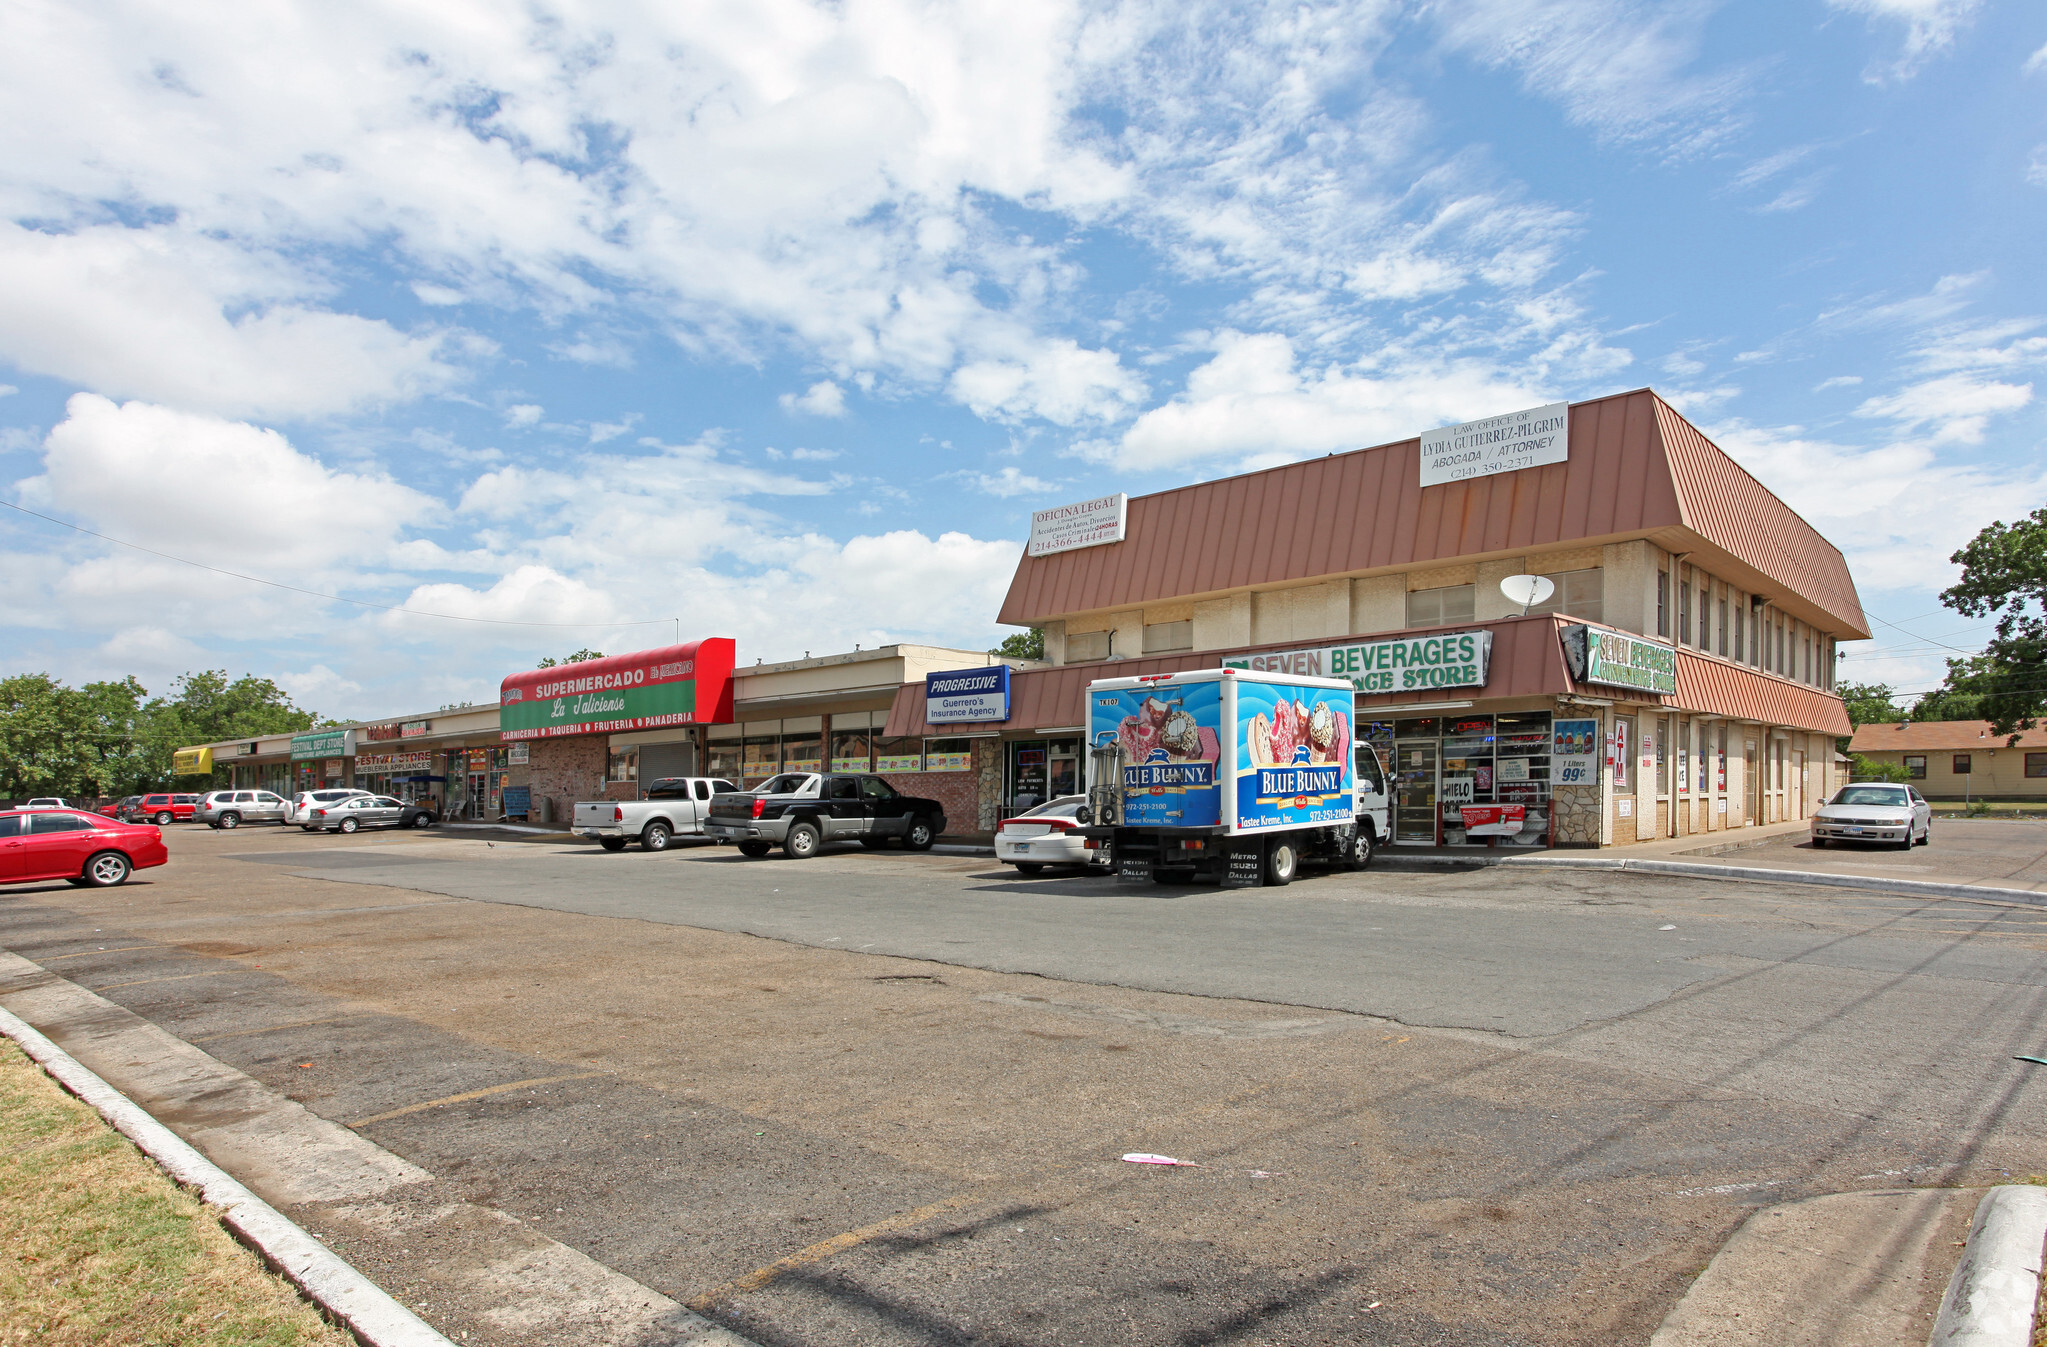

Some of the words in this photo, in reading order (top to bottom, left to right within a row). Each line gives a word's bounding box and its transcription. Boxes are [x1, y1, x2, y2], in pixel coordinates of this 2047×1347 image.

[1453, 424, 1474, 435] LAW
[1477, 416, 1513, 430] OFFICE
[1516, 412, 1531, 421] OF
[1423, 441, 1452, 457] LYDIA
[1454, 416, 1565, 450] GUTIERREZ-PILGRIM
[1431, 450, 1482, 469] ABOGADA
[1497, 436, 1556, 457] ATTORNEY
[1450, 467, 1477, 479] (214)
[1481, 455, 1534, 474] 350-2371
[1036, 506, 1079, 523] OFICINA
[1081, 498, 1116, 514] LEGAL
[1036, 526, 1065, 536] Accidentes
[1090, 514, 1117, 525] Divorcios
[1034, 530, 1103, 552] 214-366-4444
[1052, 532, 1068, 540] Casos
[1251, 650, 1322, 676] SEVEN
[1331, 635, 1475, 674] BEVERAGES
[1588, 632, 1601, 679] 7
[1600, 633, 1630, 665] SEVEN
[1630, 641, 1674, 675] BEVERAGES
[535, 668, 645, 700] SUPERMERCADO
[659, 660, 694, 680] MEXICANO
[930, 675, 999, 694] PROGRESSIVE
[1402, 664, 1477, 688] STORE
[1600, 661, 1653, 689] CONVENIENCE
[1653, 672, 1675, 693] STORE
[550, 697, 566, 718] La
[573, 693, 625, 715] Jaliciense
[942, 696, 985, 708] Guerrero's
[931, 708, 968, 718] Insurance
[968, 707, 997, 718] Agency
[502, 728, 539, 741] CARNICERIA
[548, 723, 582, 736] TAQUERIA
[594, 719, 634, 732] FRUTERIA
[645, 712, 692, 727] PANADERIA
[1457, 721, 1491, 732] OPEN
[291, 741, 313, 753] FESTIVAL
[313, 738, 327, 750] DEPT
[327, 737, 344, 749] STORE
[315, 748, 343, 757] APPLIANCES
[1616, 725, 1624, 777] ATM
[355, 765, 389, 773] MUEBLERIA
[390, 761, 431, 771] APPLIANCES
[398, 752, 431, 763] STORE
[1124, 768, 1149, 785] LUE
[1152, 767, 1206, 784] BUNNY
[1262, 771, 1295, 794] BLUE
[1445, 782, 1470, 797] HIELO
[1126, 803, 1167, 811] 972-251-2100
[1309, 808, 1349, 822] 972-251-2100
[1126, 817, 1142, 825] Tastee
[1142, 816, 1163, 826] Kreme,
[1240, 816, 1260, 828] Tastee
[1260, 814, 1282, 826] Kreme,
[1282, 812, 1294, 824] Inc.
[1230, 852, 1257, 860] METRO
[1122, 868, 1149, 876] DALLAS
[1228, 871, 1258, 879] DALLAS
